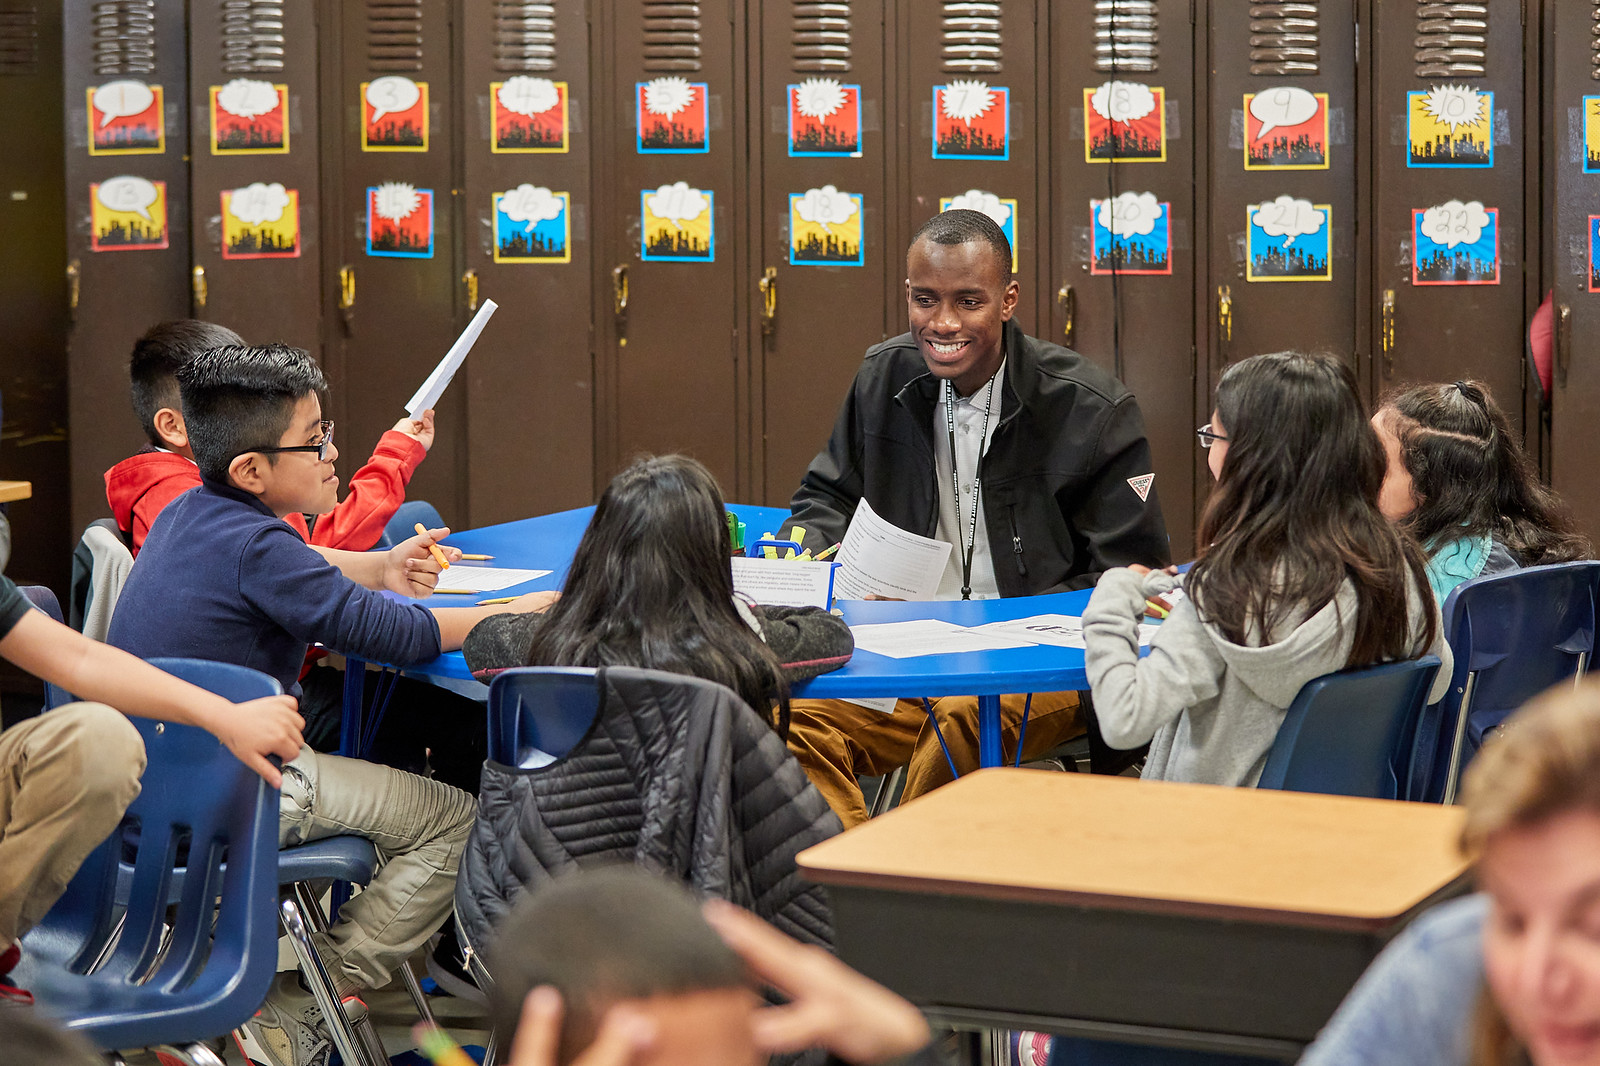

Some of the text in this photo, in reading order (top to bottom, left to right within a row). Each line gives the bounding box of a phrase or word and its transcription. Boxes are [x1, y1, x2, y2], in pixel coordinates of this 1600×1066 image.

[238, 83, 255, 109] 2
[380, 80, 399, 108] 3
[516, 82, 541, 112] 4
[656, 84, 673, 105] 5
[809, 86, 827, 112] 6
[956, 89, 969, 113] 7
[1115, 87, 1131, 114] 8
[1273, 89, 1292, 119] 9
[1439, 91, 1466, 118] 10
[114, 181, 139, 205] 13
[514, 188, 538, 214] 16
[812, 193, 833, 218] 18
[1113, 199, 1142, 223] 20
[1271, 204, 1300, 230] 21
[1434, 209, 1470, 237] 22
